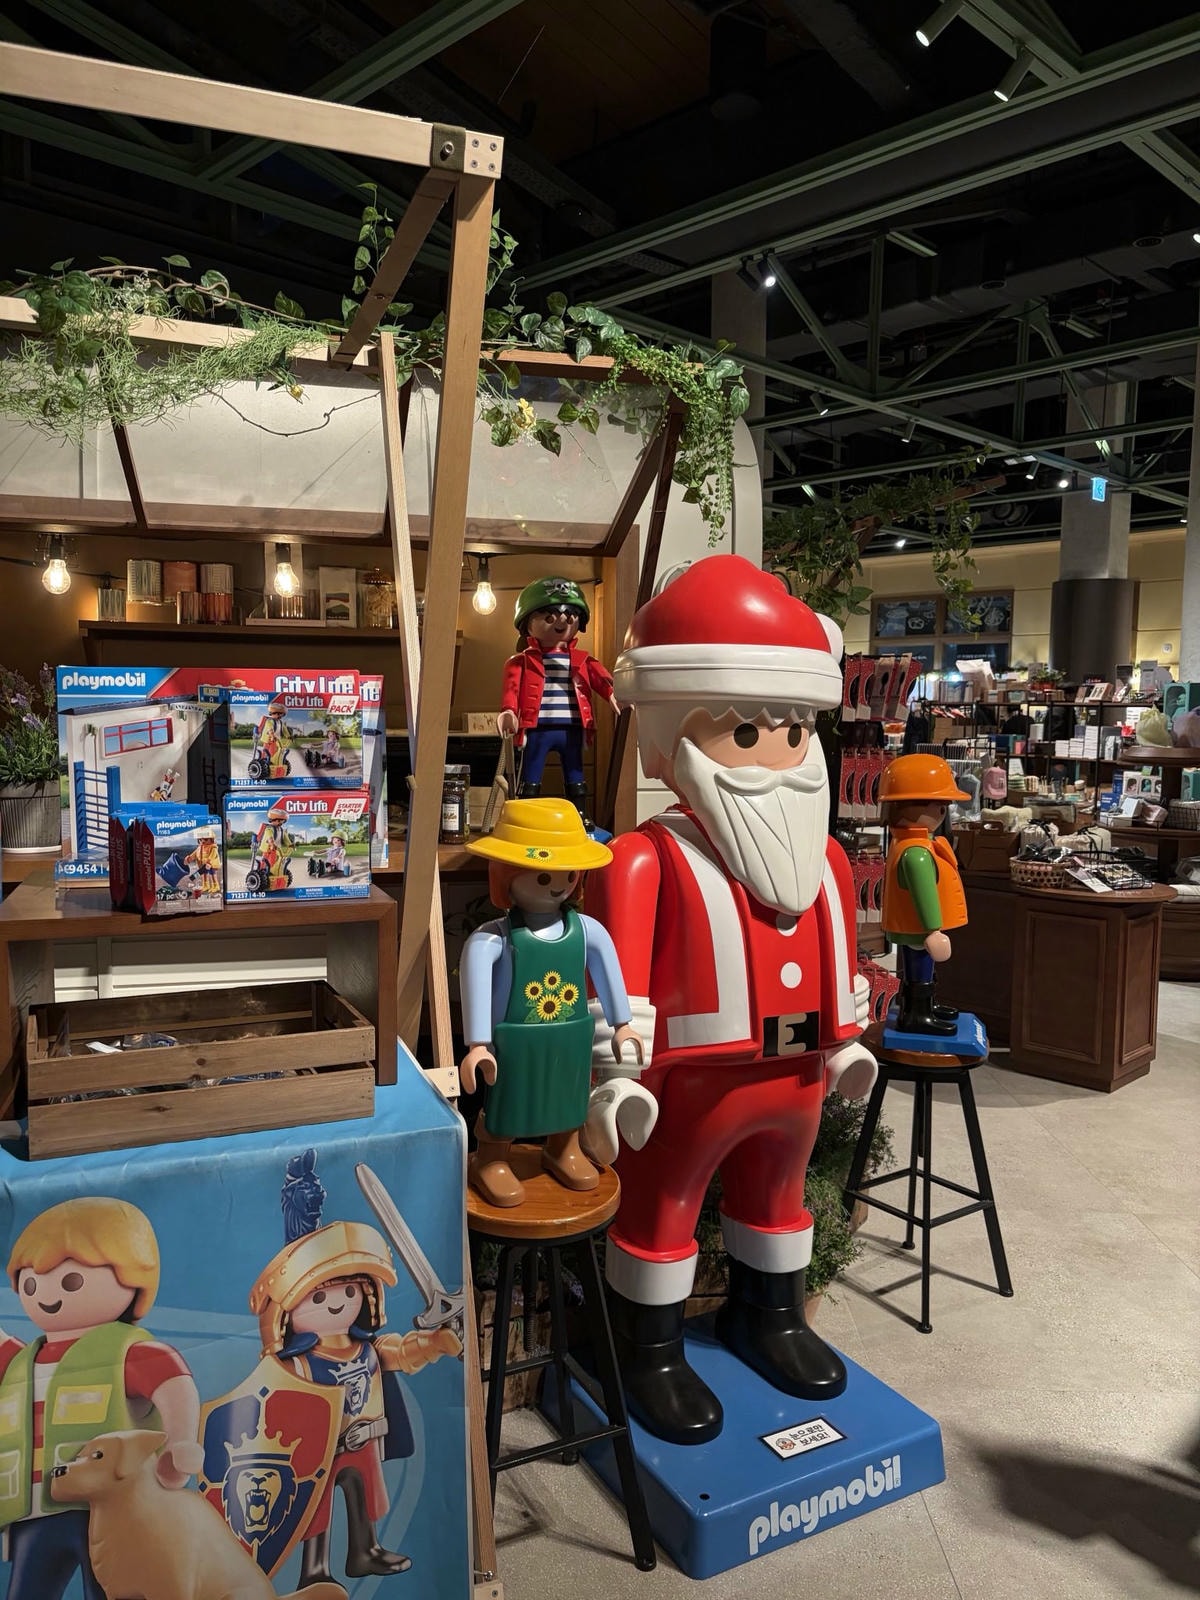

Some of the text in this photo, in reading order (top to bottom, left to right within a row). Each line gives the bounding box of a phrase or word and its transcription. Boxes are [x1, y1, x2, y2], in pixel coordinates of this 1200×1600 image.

[62, 672, 146, 690] playmobil
[275, 675, 316, 693] City
[231, 694, 269, 703] playmobil
[285, 696, 304, 706] City
[306, 696, 324, 707] Life
[330, 705, 353, 713] PACK
[228, 799, 269, 809] playmobil
[286, 800, 328, 812] City Life
[156, 820, 197, 831] playmobil
[788, 1424, 825, 1441] 눈으로만
[799, 1432, 831, 1446] 보세요!
[748, 1454, 902, 1556] playmobil
